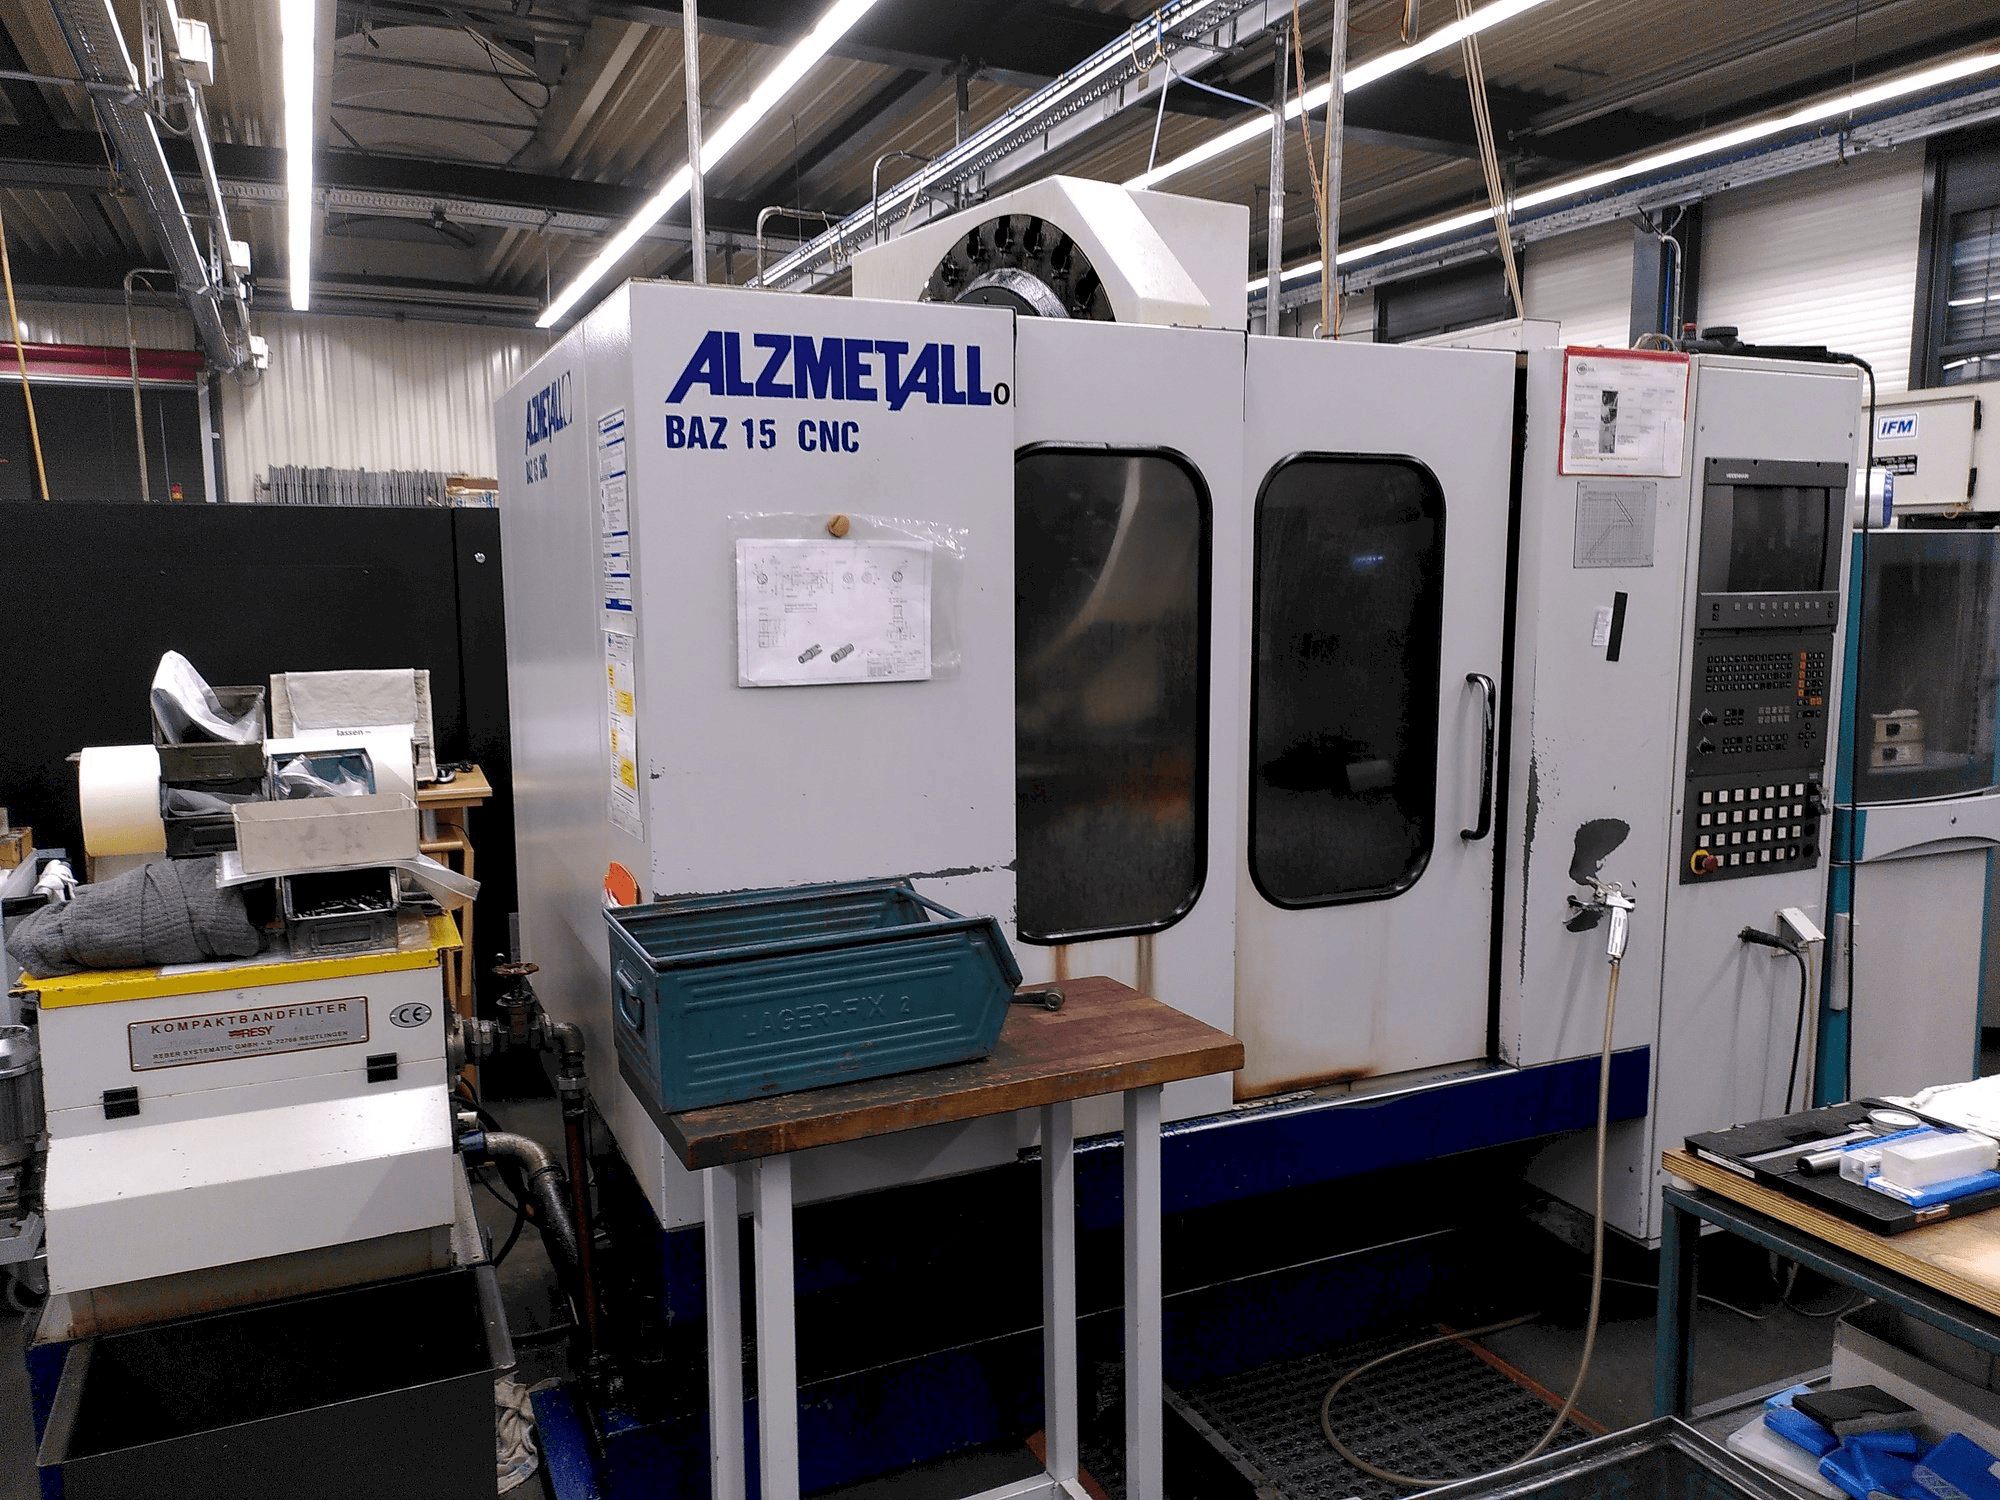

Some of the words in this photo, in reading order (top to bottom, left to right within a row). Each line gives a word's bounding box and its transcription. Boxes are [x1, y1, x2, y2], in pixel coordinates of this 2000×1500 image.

[665, 330, 992, 412] ALZMETALL
[665, 415, 728, 449] BAZ
[741, 418, 777, 449] 15
[797, 419, 861, 453] CNC
[1881, 420, 1914, 434] IFM
[150, 1003, 348, 1035] KOMPAKTBANDFILTER
[241, 1025, 273, 1038] RESY
[152, 1049, 181, 1060] REBER
[182, 1044, 233, 1056] SYSTEMATIC
[298, 1030, 349, 1041] REUTLINGEN
